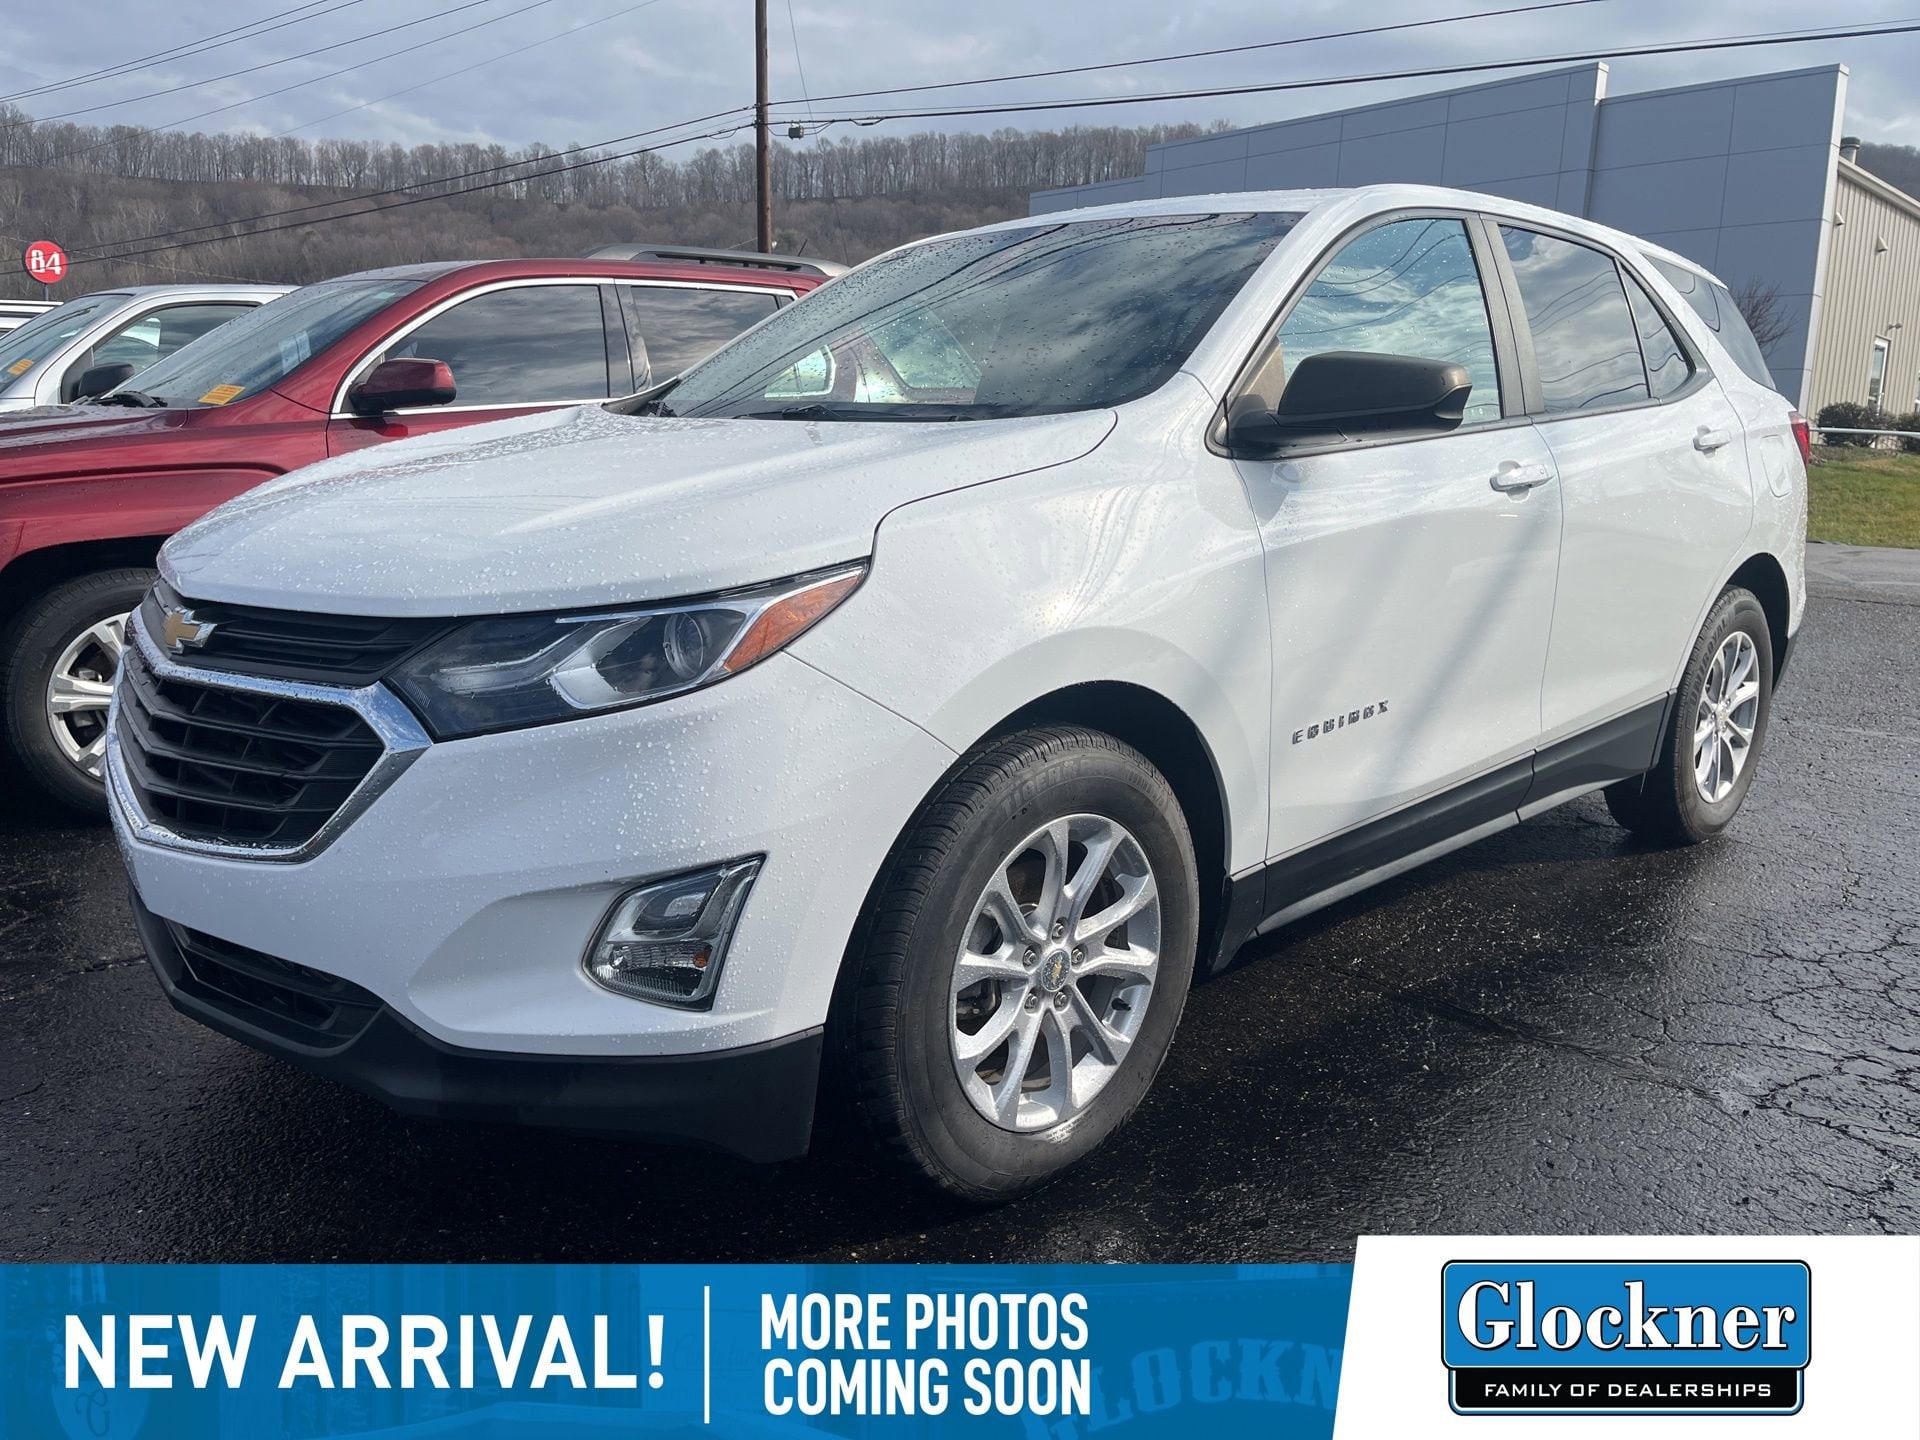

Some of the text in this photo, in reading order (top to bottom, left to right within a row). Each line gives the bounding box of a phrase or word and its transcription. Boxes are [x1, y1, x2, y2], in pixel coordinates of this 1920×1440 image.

[31, 249, 62, 275] 84
[1689, 618, 1728, 706] UNIROYAL
[1292, 700, 1389, 745] EQUINOX
